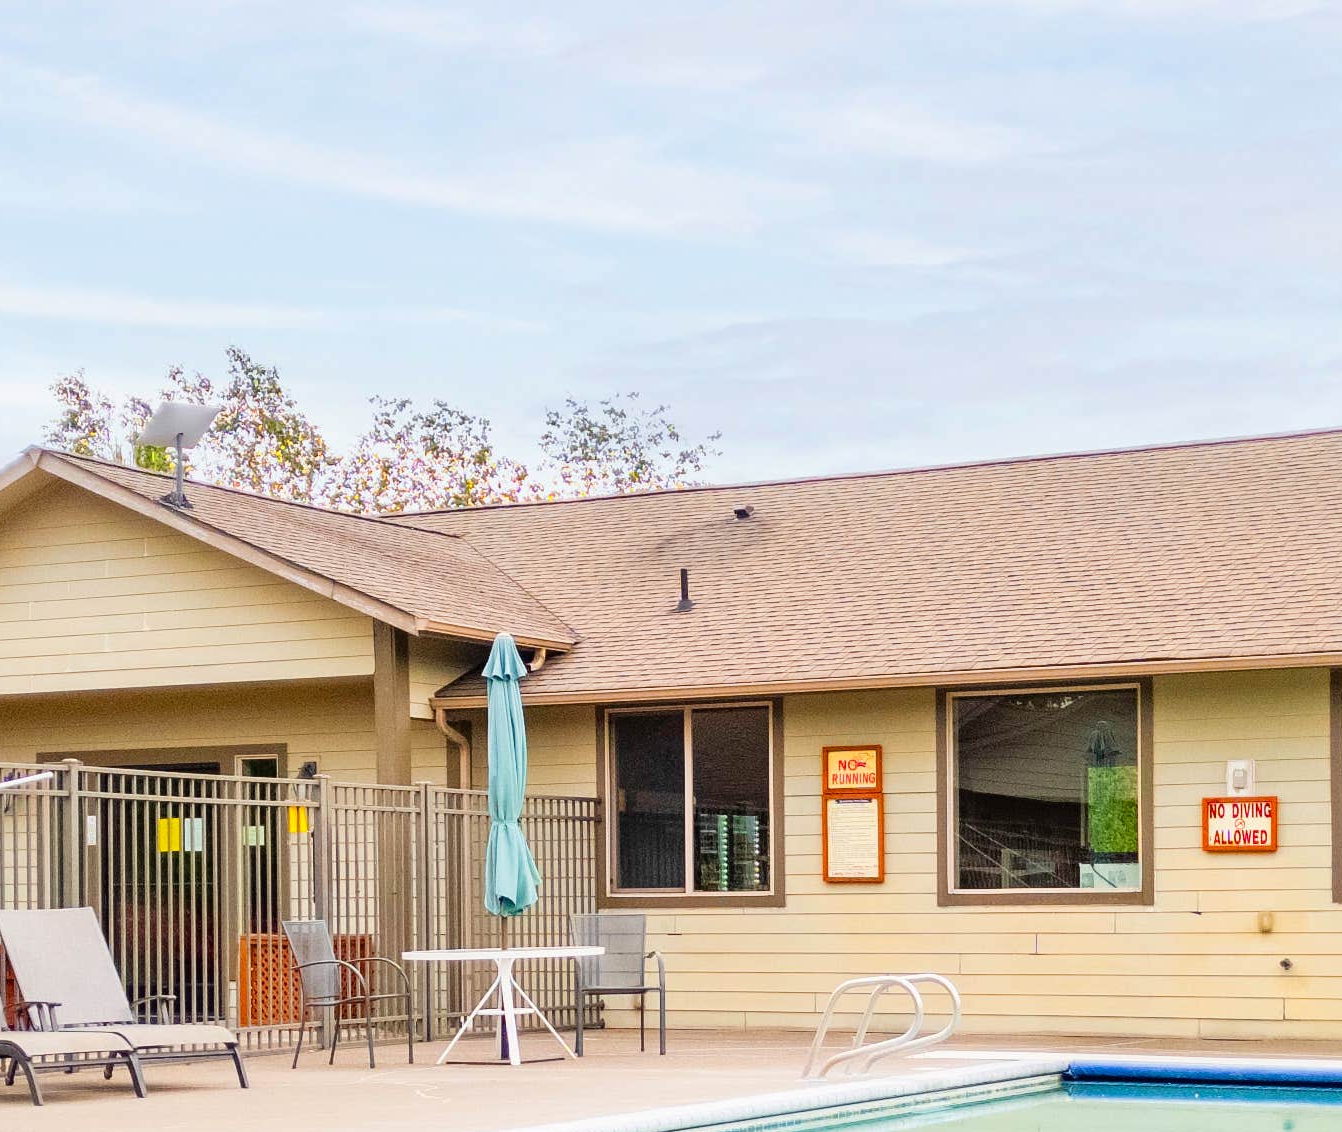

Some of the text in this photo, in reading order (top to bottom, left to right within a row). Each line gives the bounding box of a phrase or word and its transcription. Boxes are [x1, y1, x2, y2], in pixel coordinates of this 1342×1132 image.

[838, 759, 857, 771] NO
[832, 772, 876, 785] RUNNING
[1209, 802, 1272, 819] NO DIVING
[1214, 829, 1268, 845] ALLOWED
